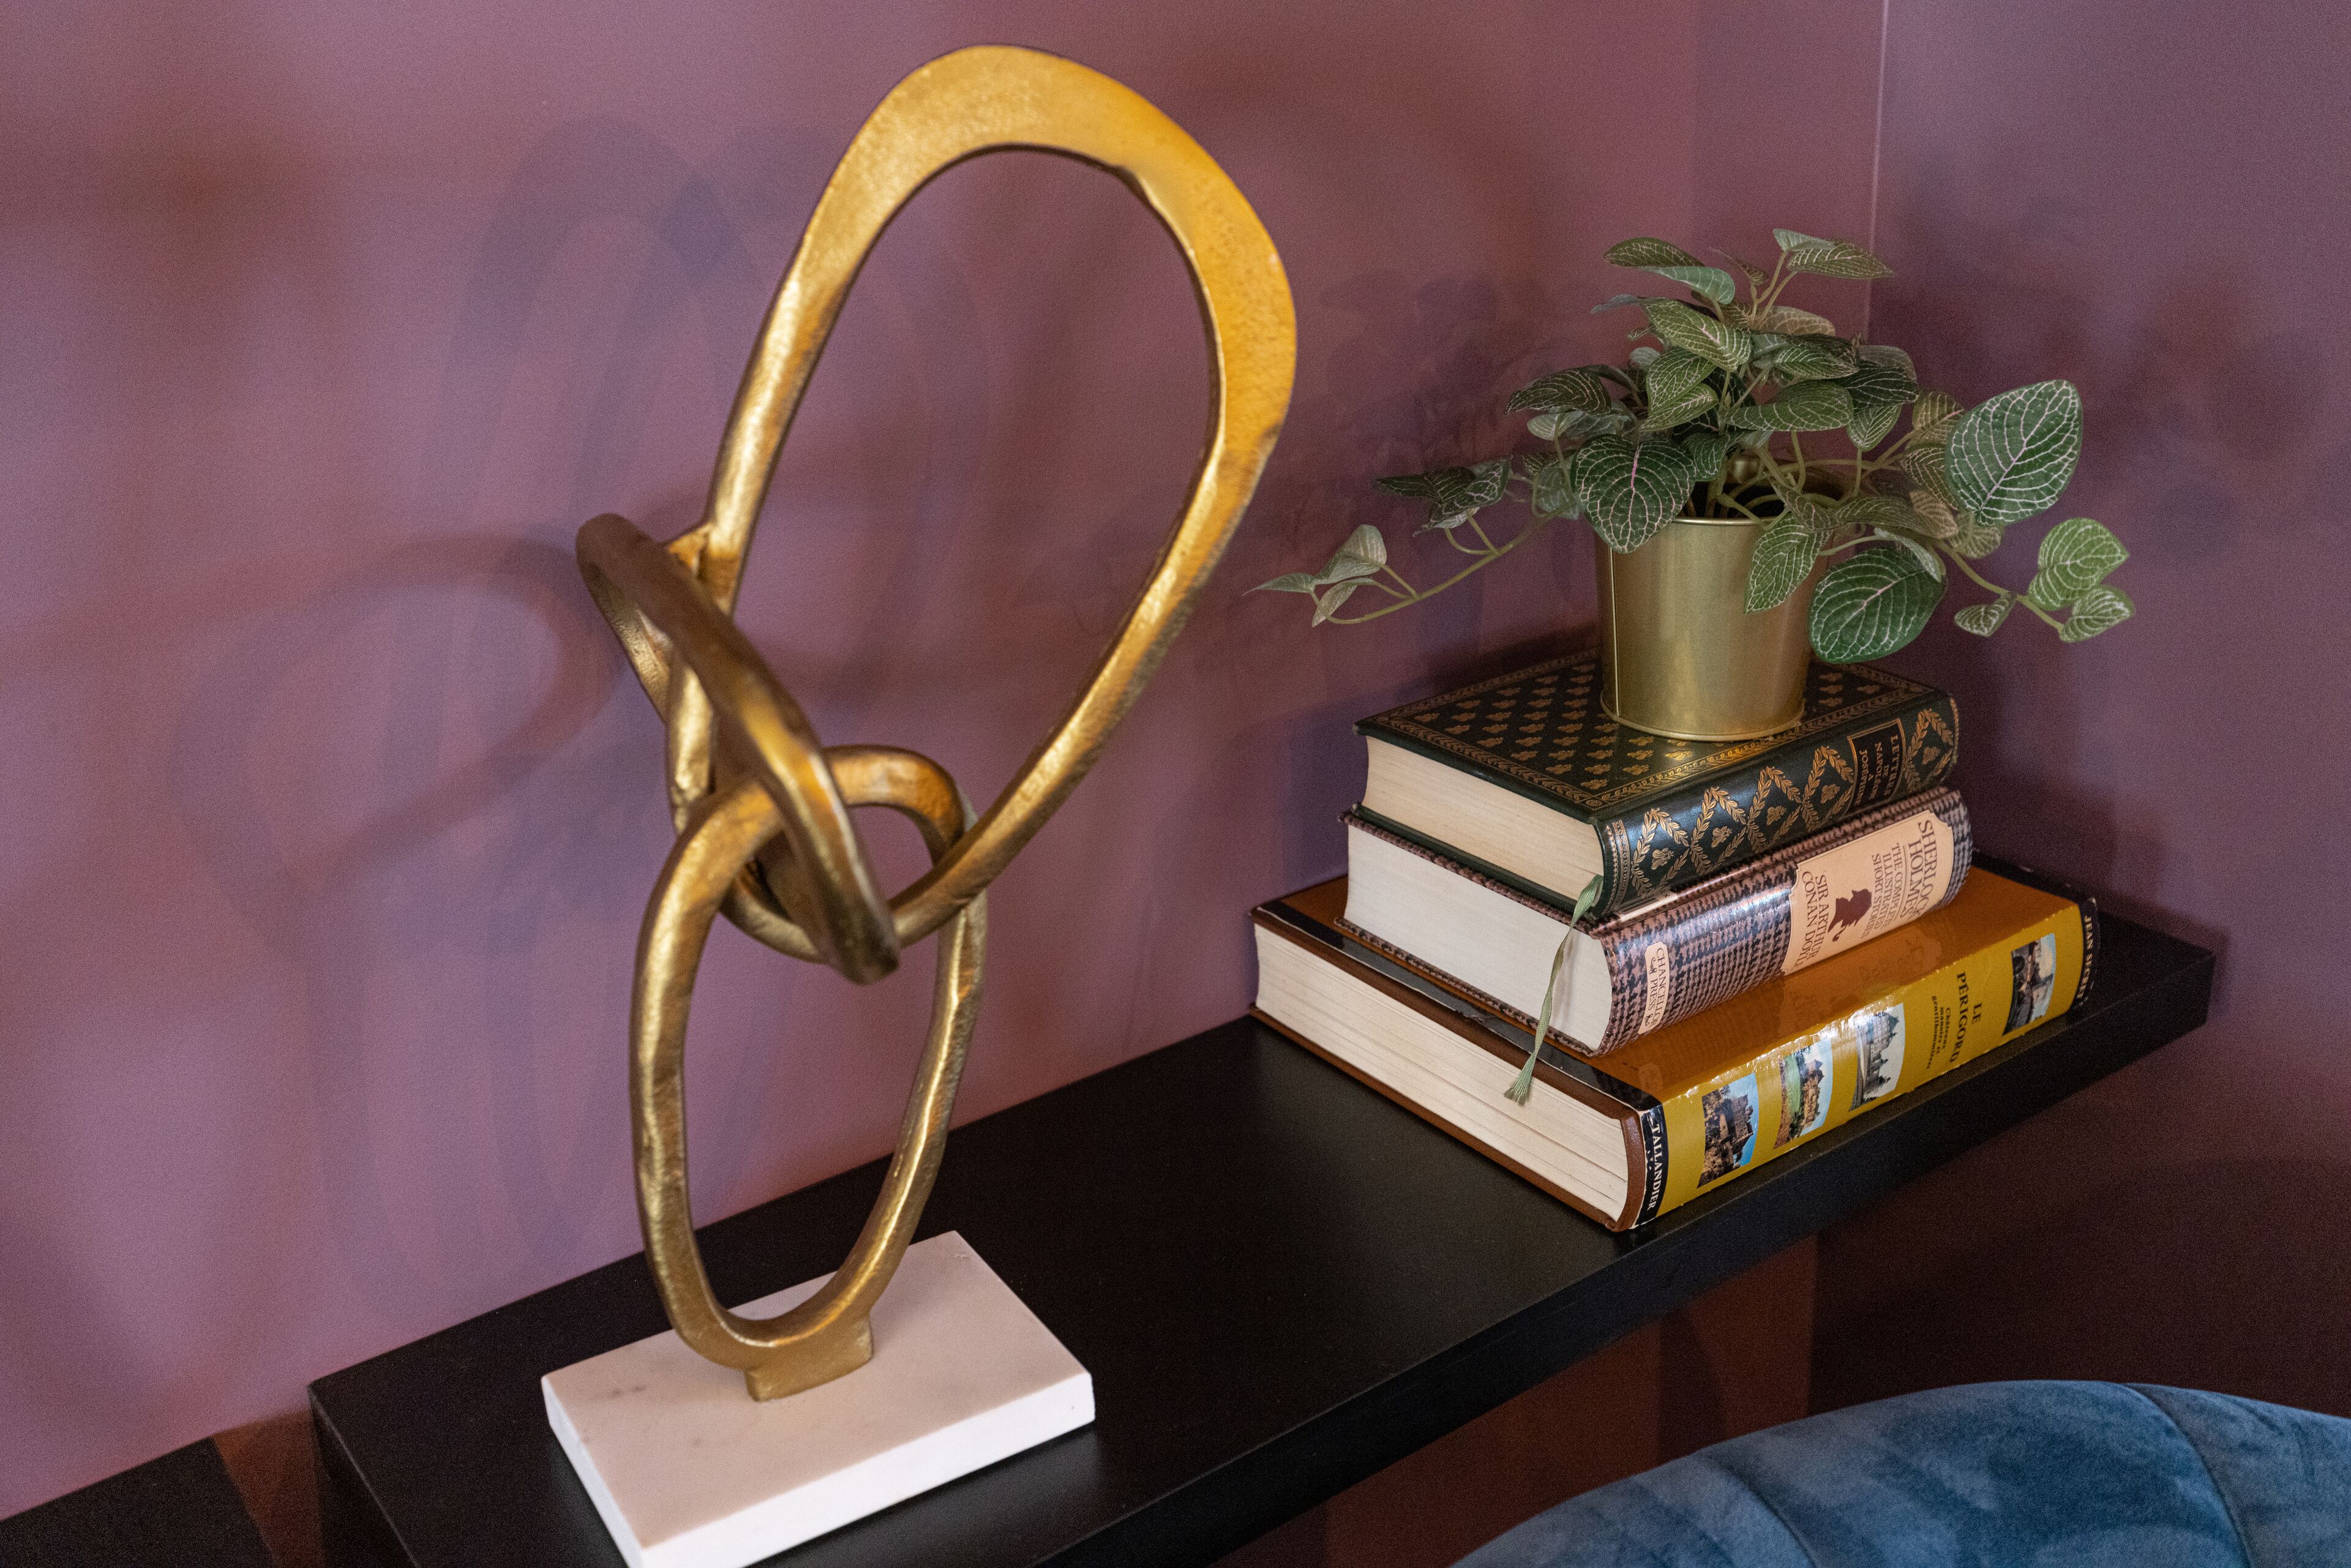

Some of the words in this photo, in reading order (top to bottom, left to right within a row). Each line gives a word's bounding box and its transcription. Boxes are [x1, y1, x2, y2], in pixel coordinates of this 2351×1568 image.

[1883, 764, 1889, 778] DE
[1884, 735, 1899, 795] LETTRES
[1872, 853, 1883, 893] SHORT
[1892, 842, 1903, 871] THE
[1900, 838, 1924, 918] HOLMES
[1908, 820, 1938, 920] SHERLOCK
[1802, 871, 1818, 928] CONAN
[1815, 875, 1829, 901] SIR
[1874, 853, 1893, 929] ILLUSTRATED
[1881, 871, 1903, 929] COMPLETE
[1791, 930, 1816, 970] DOYLE
[1806, 904, 1829, 961] ARTHUR
[2084, 915, 2093, 949] JEAN
[1648, 978, 1659, 1011] PRESS
[1649, 948, 1666, 1027] CHANCELLOR
[1973, 1002, 1982, 1024] LE
[1647, 1123, 1663, 1211] TALLANDIER
